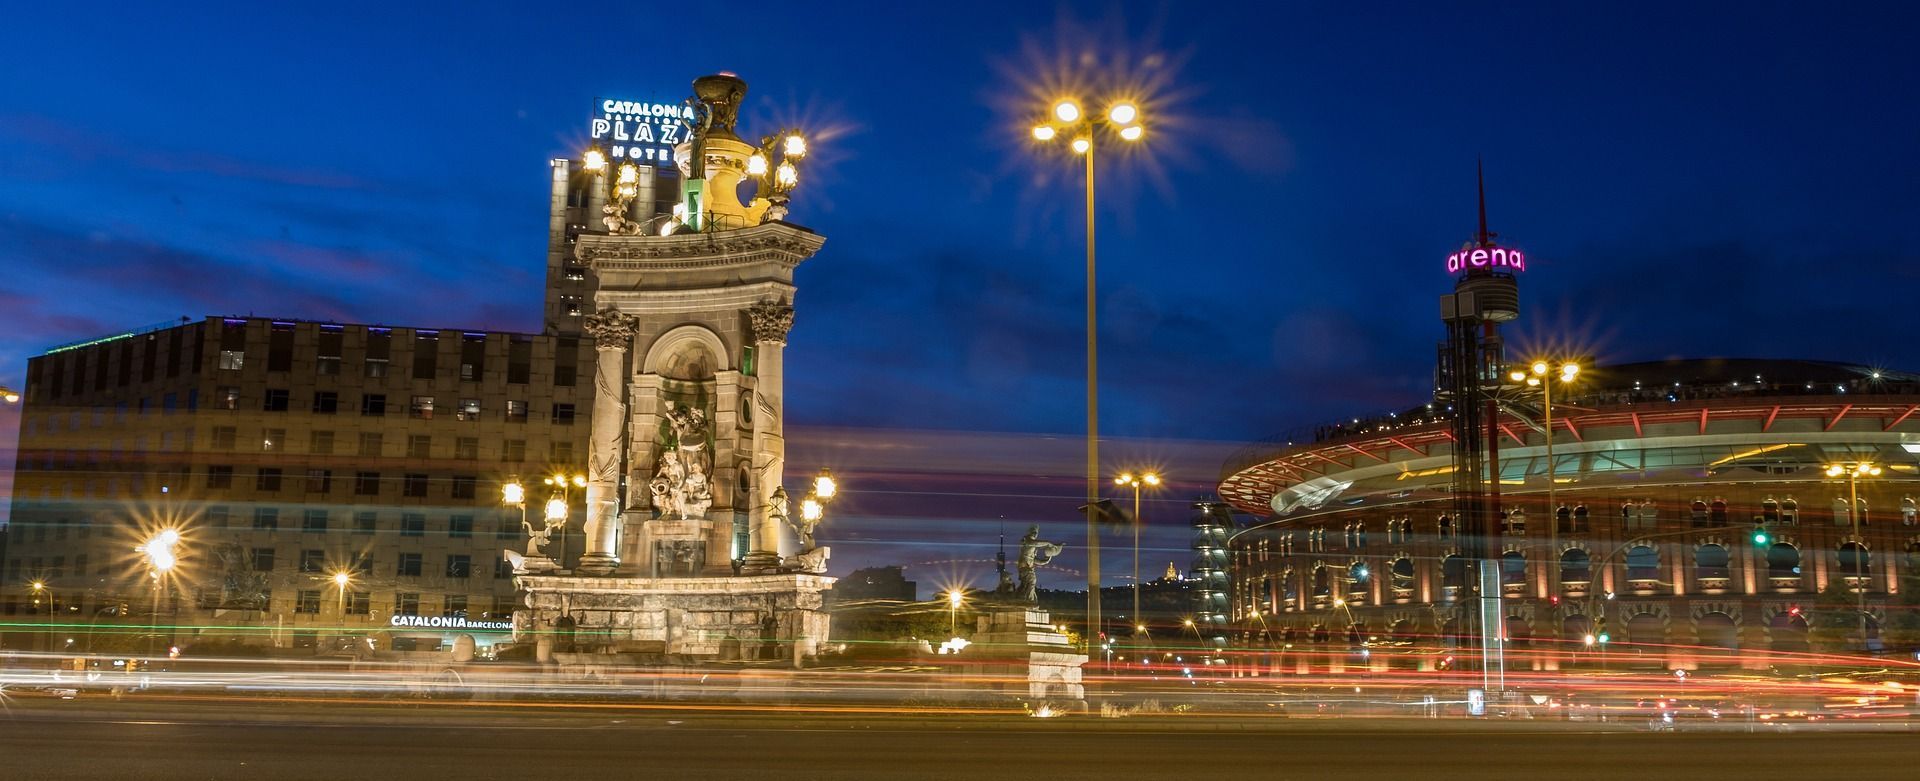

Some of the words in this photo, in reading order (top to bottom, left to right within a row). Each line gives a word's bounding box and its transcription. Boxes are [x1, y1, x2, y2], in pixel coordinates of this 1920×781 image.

[603, 99, 694, 119] CATALONIA
[605, 113, 681, 126] BARCELON
[612, 145, 676, 161] HOTE
[391, 615, 466, 628] CATALONIA
[467, 621, 513, 629] BARCELONA
